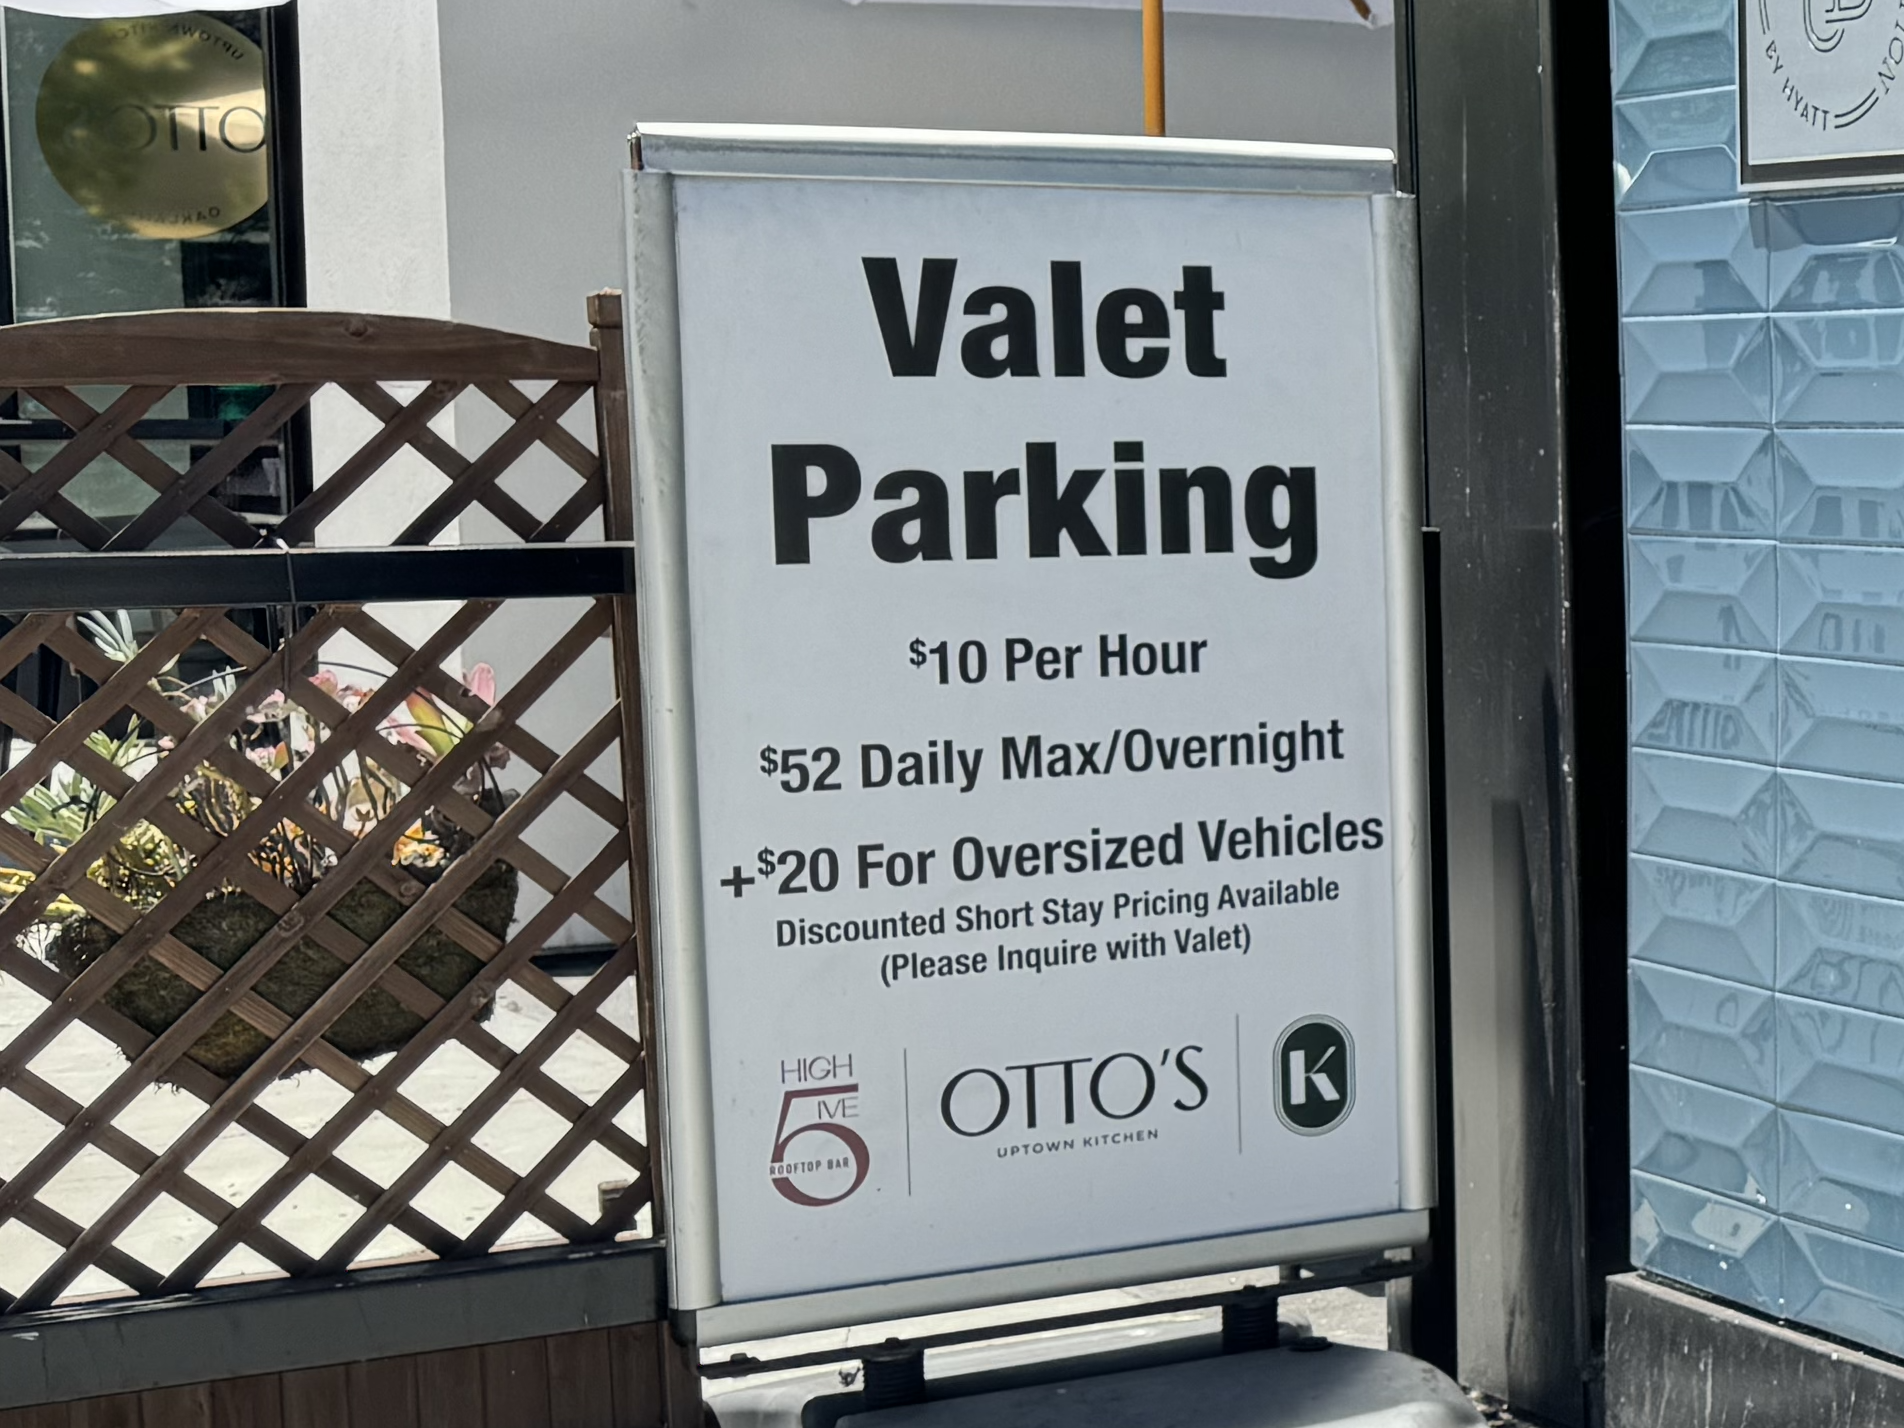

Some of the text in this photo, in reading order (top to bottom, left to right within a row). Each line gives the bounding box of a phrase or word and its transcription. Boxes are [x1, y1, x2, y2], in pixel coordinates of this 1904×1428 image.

[1765, 40, 1830, 132] BY HYATT
[862, 256, 1228, 379] Valet
[771, 440, 1319, 580] Parking
[909, 633, 1208, 686] $10 Per Hour
[759, 719, 1345, 794] $52 Daily Max/Overnight
[720, 811, 1385, 899] +$20 For Oversized Vehicles
[776, 876, 1340, 947] Discounted Short Stay Pricing Available
[881, 923, 1251, 988] (Please Inquire with Valet)
[780, 1052, 854, 1085] HIGH
[940, 1045, 1210, 1138] OTTO'S
[1289, 1045, 1341, 1105] K
[769, 1155, 851, 1178] ROOFTOP BAR
[996, 1128, 1160, 1160] UPTOWN KITCHEN
